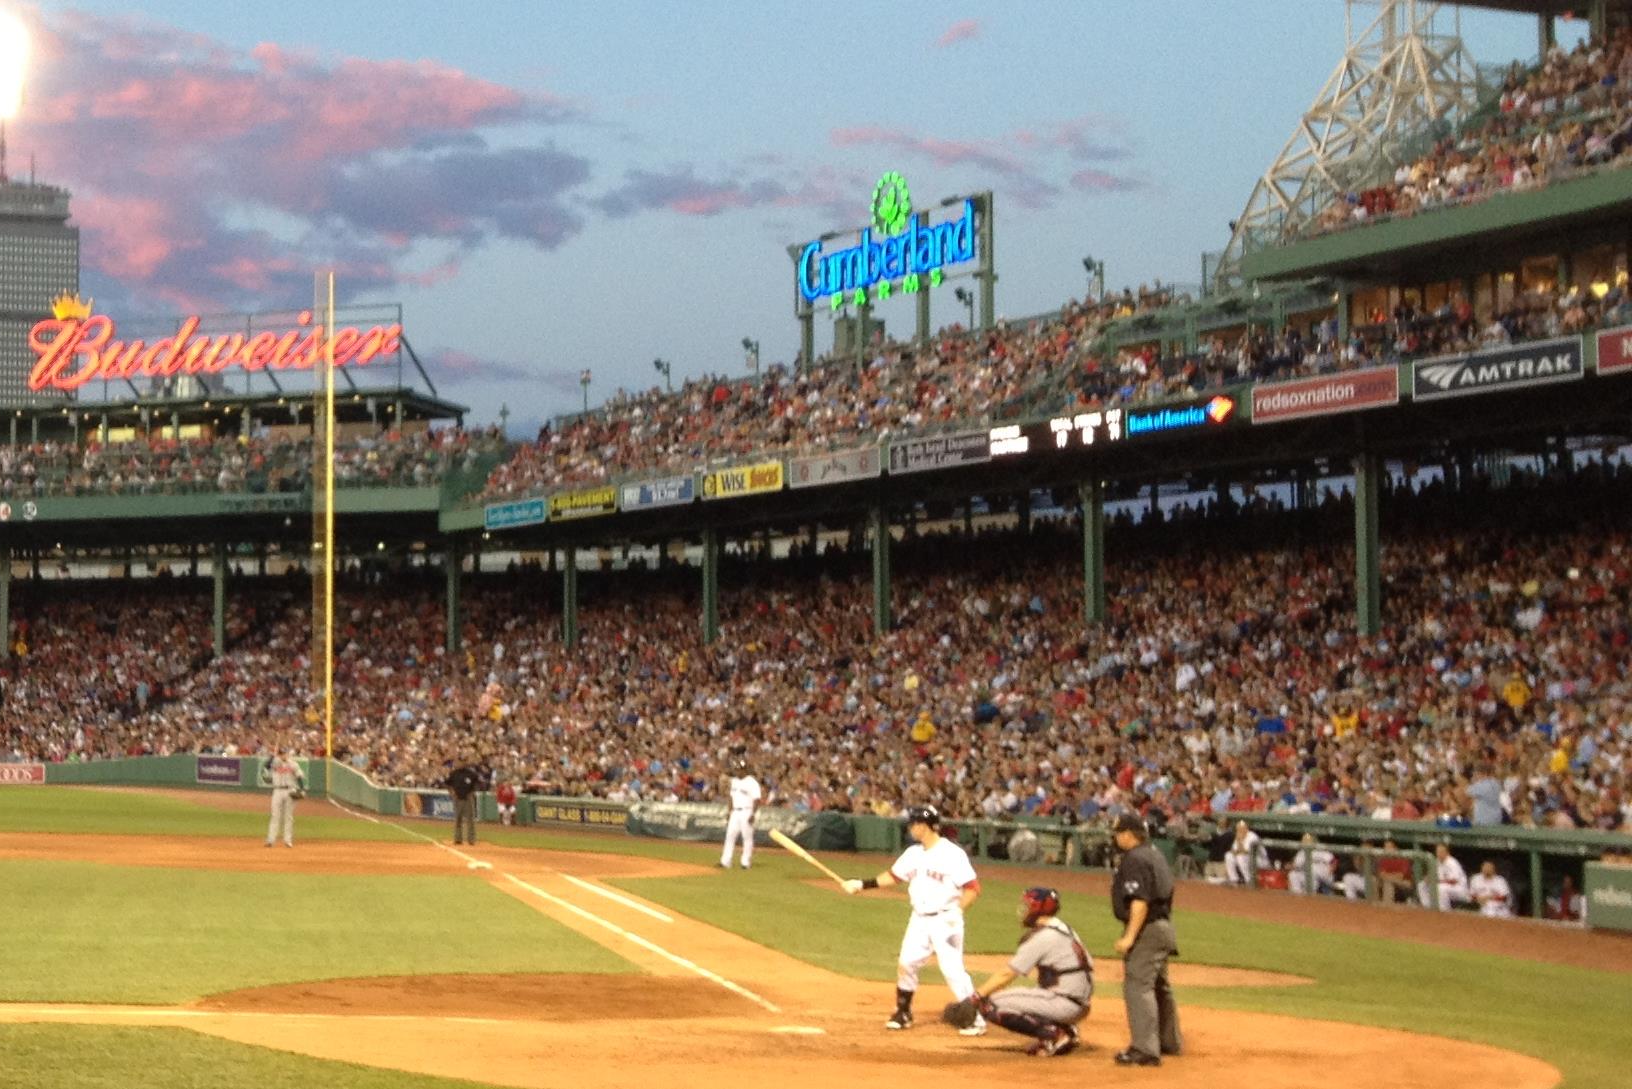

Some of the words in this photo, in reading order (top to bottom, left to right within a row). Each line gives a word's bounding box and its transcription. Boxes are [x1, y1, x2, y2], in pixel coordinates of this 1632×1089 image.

[799, 197, 976, 302] Cumberland
[831, 267, 944, 312] FARMS
[28, 311, 403, 391] Budweiser
[1459, 352, 1572, 386] AMTRAK
[1129, 413, 1153, 433] Bank
[1154, 411, 1164, 427] of
[1164, 406, 1206, 428] America
